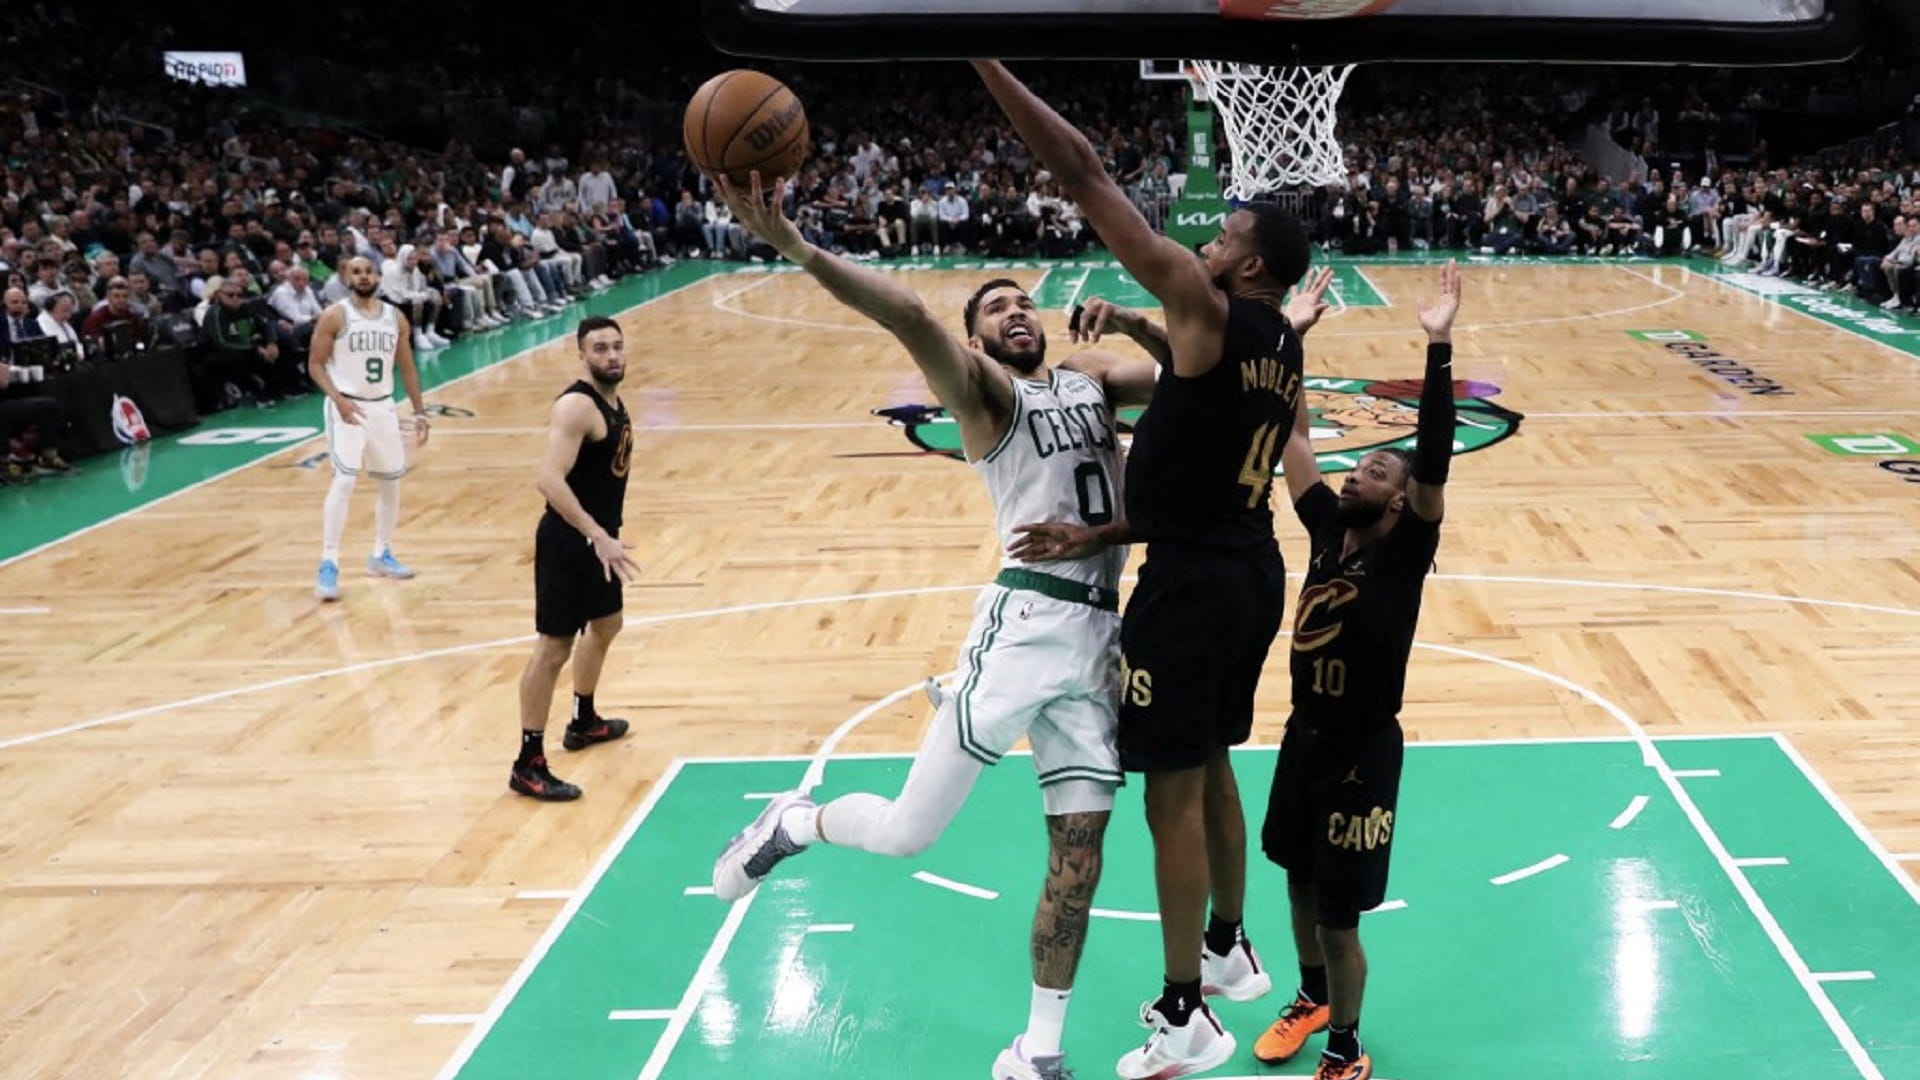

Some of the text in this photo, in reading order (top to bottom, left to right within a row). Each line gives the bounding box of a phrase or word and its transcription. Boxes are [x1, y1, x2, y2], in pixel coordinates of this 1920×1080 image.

[349, 330, 395, 352] CELTICS
[365, 357, 384, 384] 9
[1664, 341, 1796, 396] GARDEN
[1237, 421, 1281, 509] 4
[1073, 461, 1114, 527] 0
[1311, 657, 1346, 697] 10
[1328, 805, 1393, 851] CAVS
